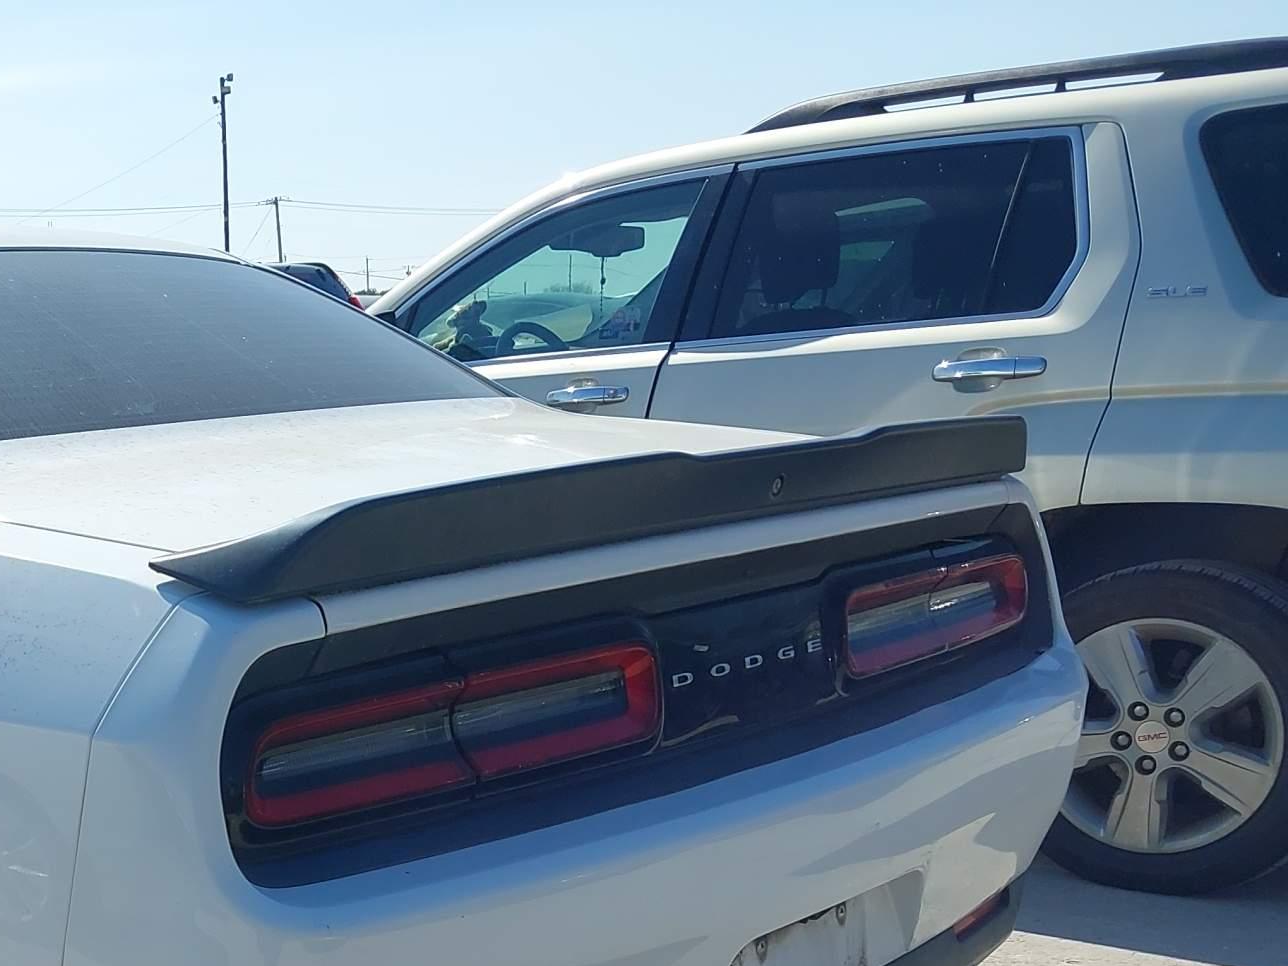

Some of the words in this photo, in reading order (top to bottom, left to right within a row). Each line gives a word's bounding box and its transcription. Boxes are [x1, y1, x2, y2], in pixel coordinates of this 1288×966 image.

[1145, 285, 1209, 299] SLE
[671, 638, 823, 688] DODGE
[1137, 731, 1169, 742] GMC
